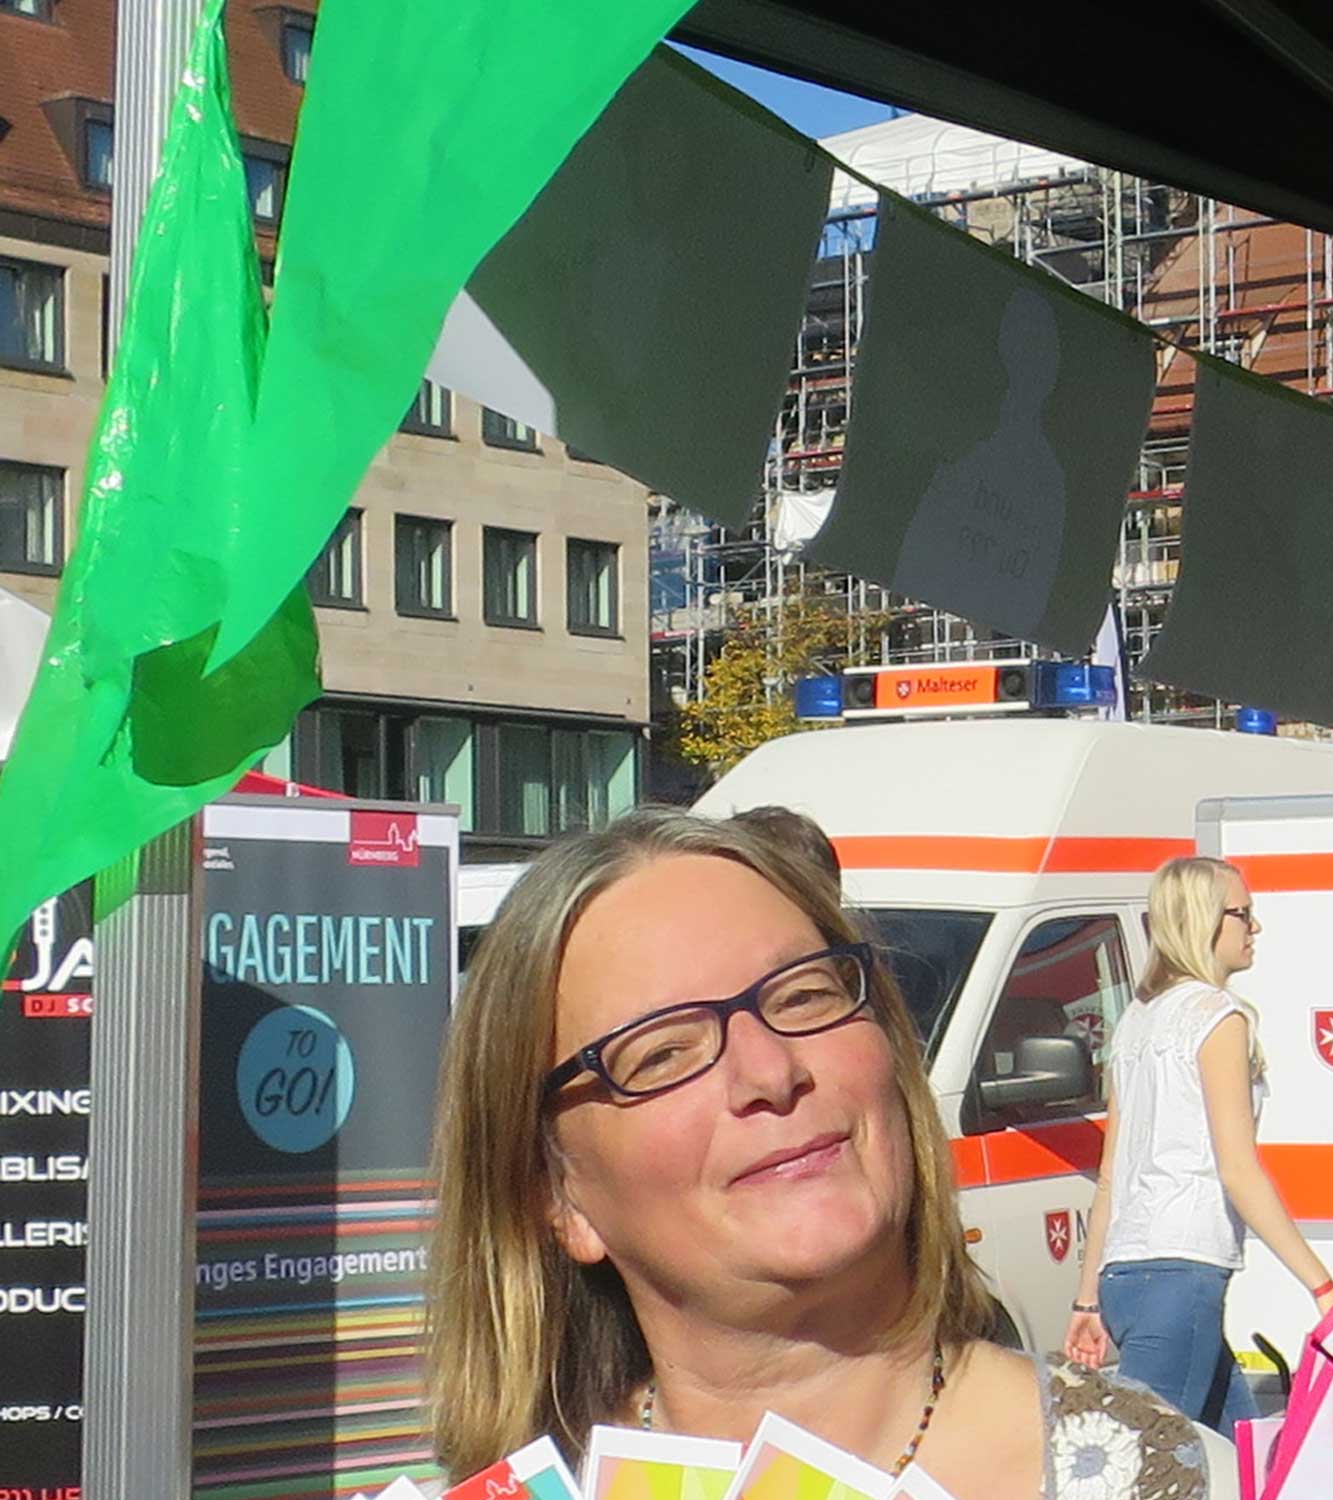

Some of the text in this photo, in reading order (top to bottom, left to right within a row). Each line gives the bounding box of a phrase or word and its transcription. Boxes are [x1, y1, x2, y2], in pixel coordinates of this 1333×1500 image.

[917, 675, 978, 694] Malteser
[208, 912, 433, 985] GAGEMENT
[31, 999, 55, 1013] DJ
[286, 1029, 318, 1058] TO
[255, 1066, 335, 1117] GO!
[0, 1222, 88, 1248] LERI
[264, 1246, 428, 1284] Engagement
